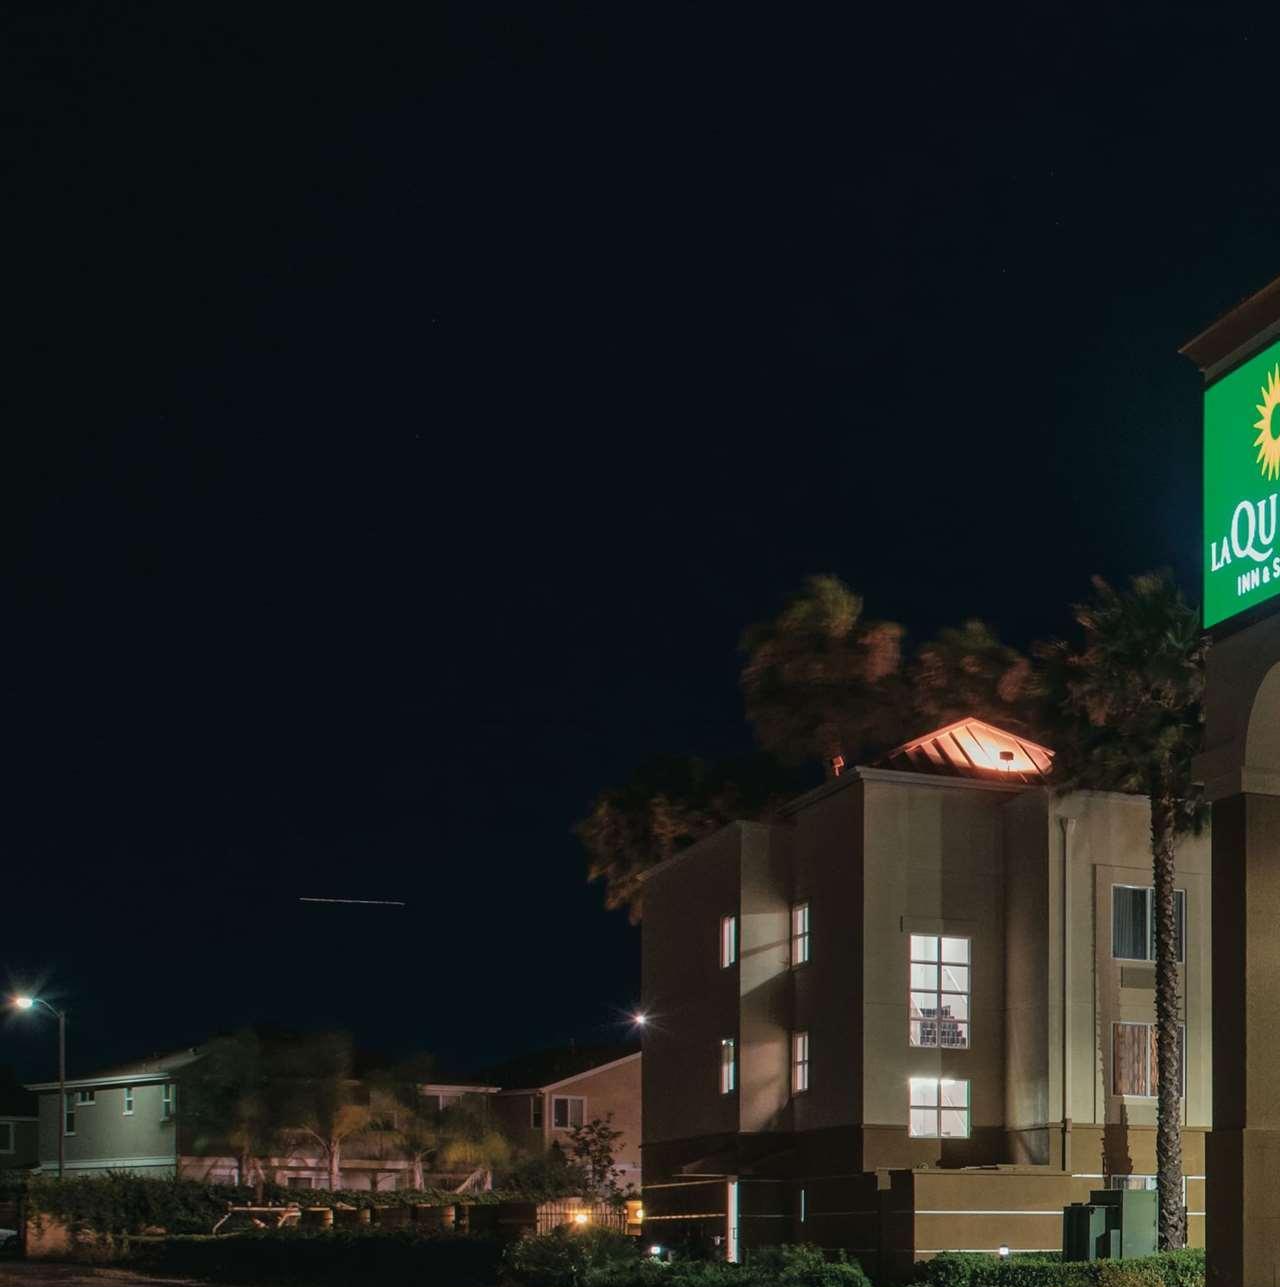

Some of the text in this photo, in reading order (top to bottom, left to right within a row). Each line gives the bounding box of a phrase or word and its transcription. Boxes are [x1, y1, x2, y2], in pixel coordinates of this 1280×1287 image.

[1211, 536, 1232, 572] LA
[1237, 567, 1260, 596] INN
[1262, 566, 1271, 584] &
